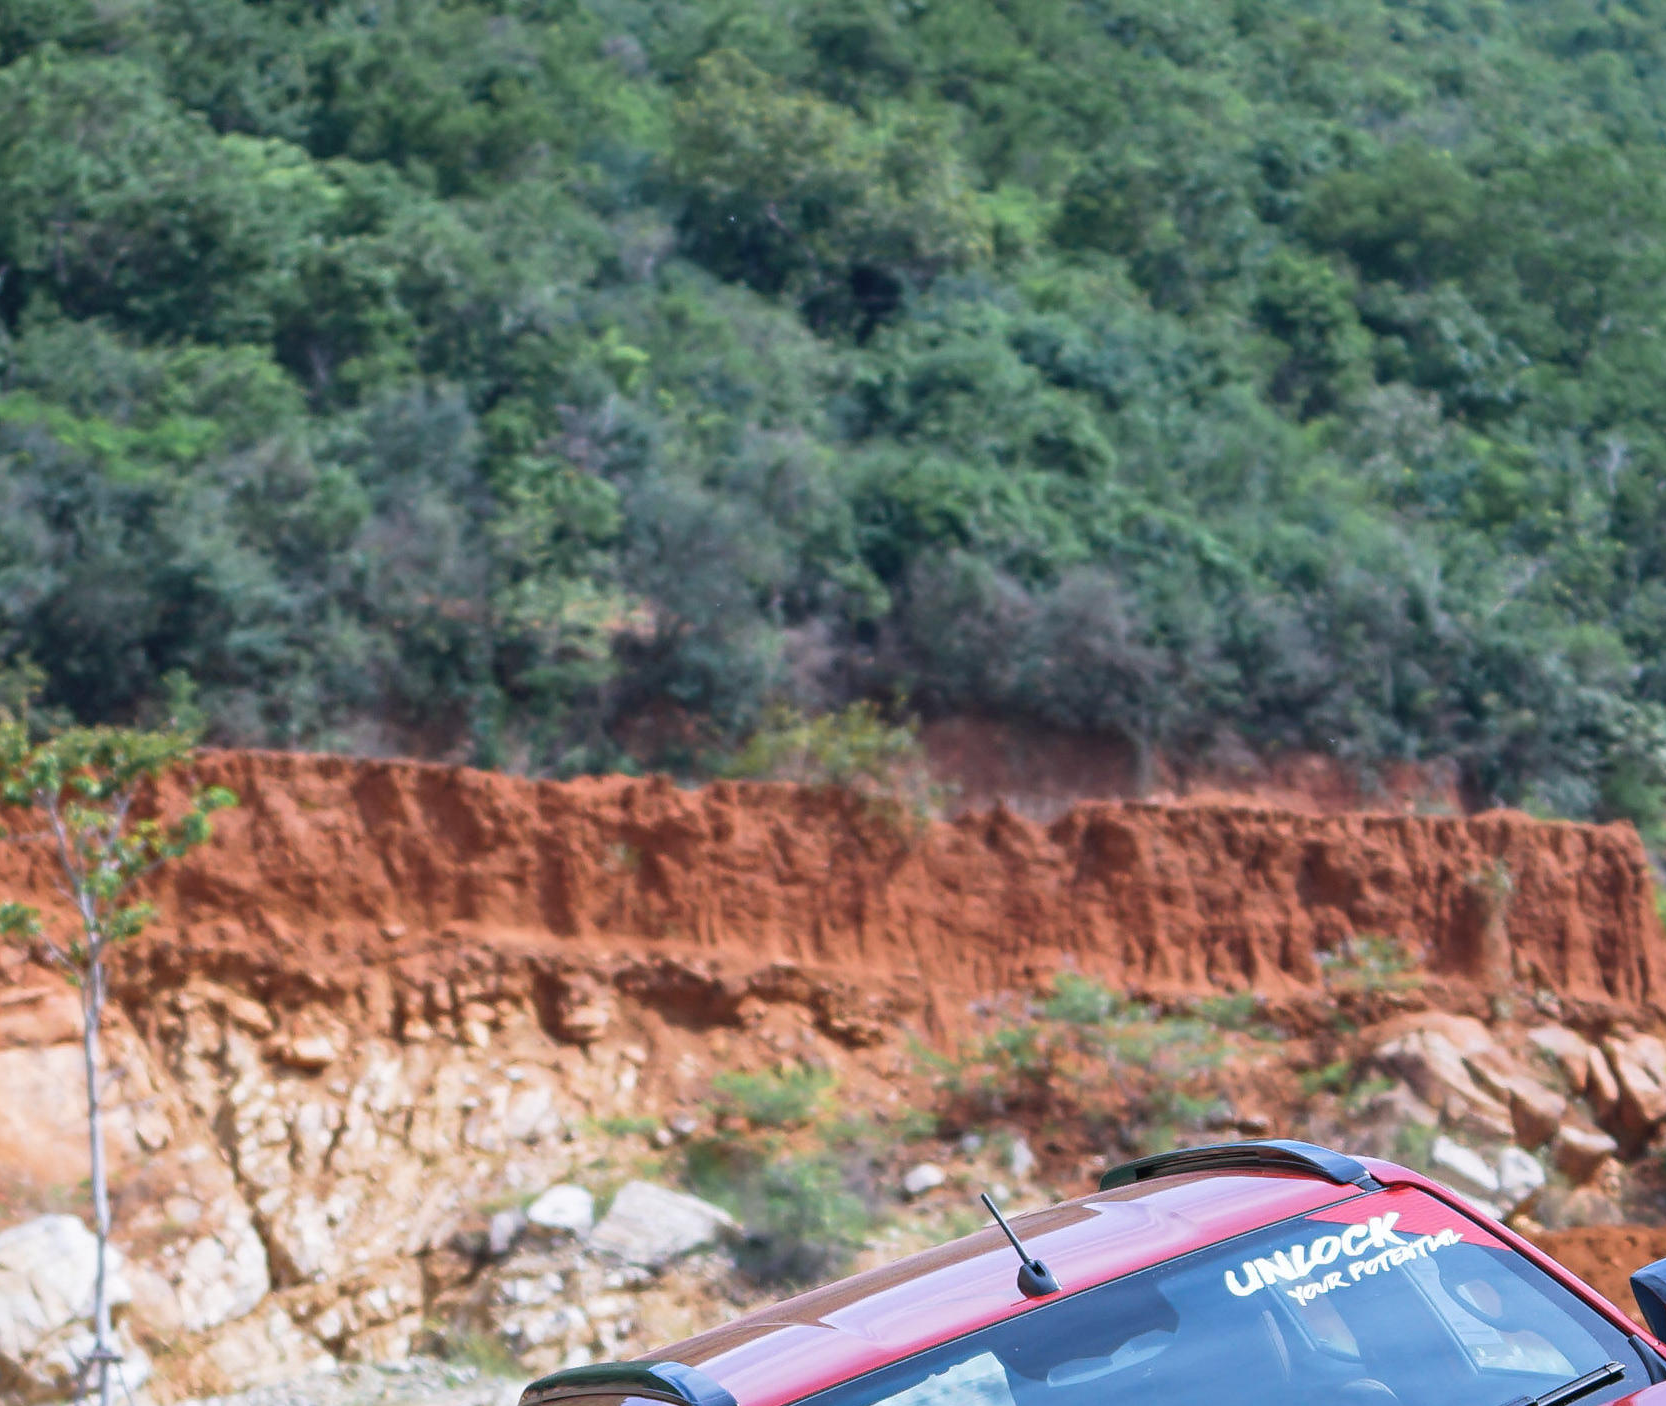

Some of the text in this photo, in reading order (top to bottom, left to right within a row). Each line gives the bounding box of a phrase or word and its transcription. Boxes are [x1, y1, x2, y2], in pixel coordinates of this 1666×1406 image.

[1224, 1211, 1409, 1297] UNLOCK
[1287, 1228, 1465, 1307] YOUR POTENTIAL
